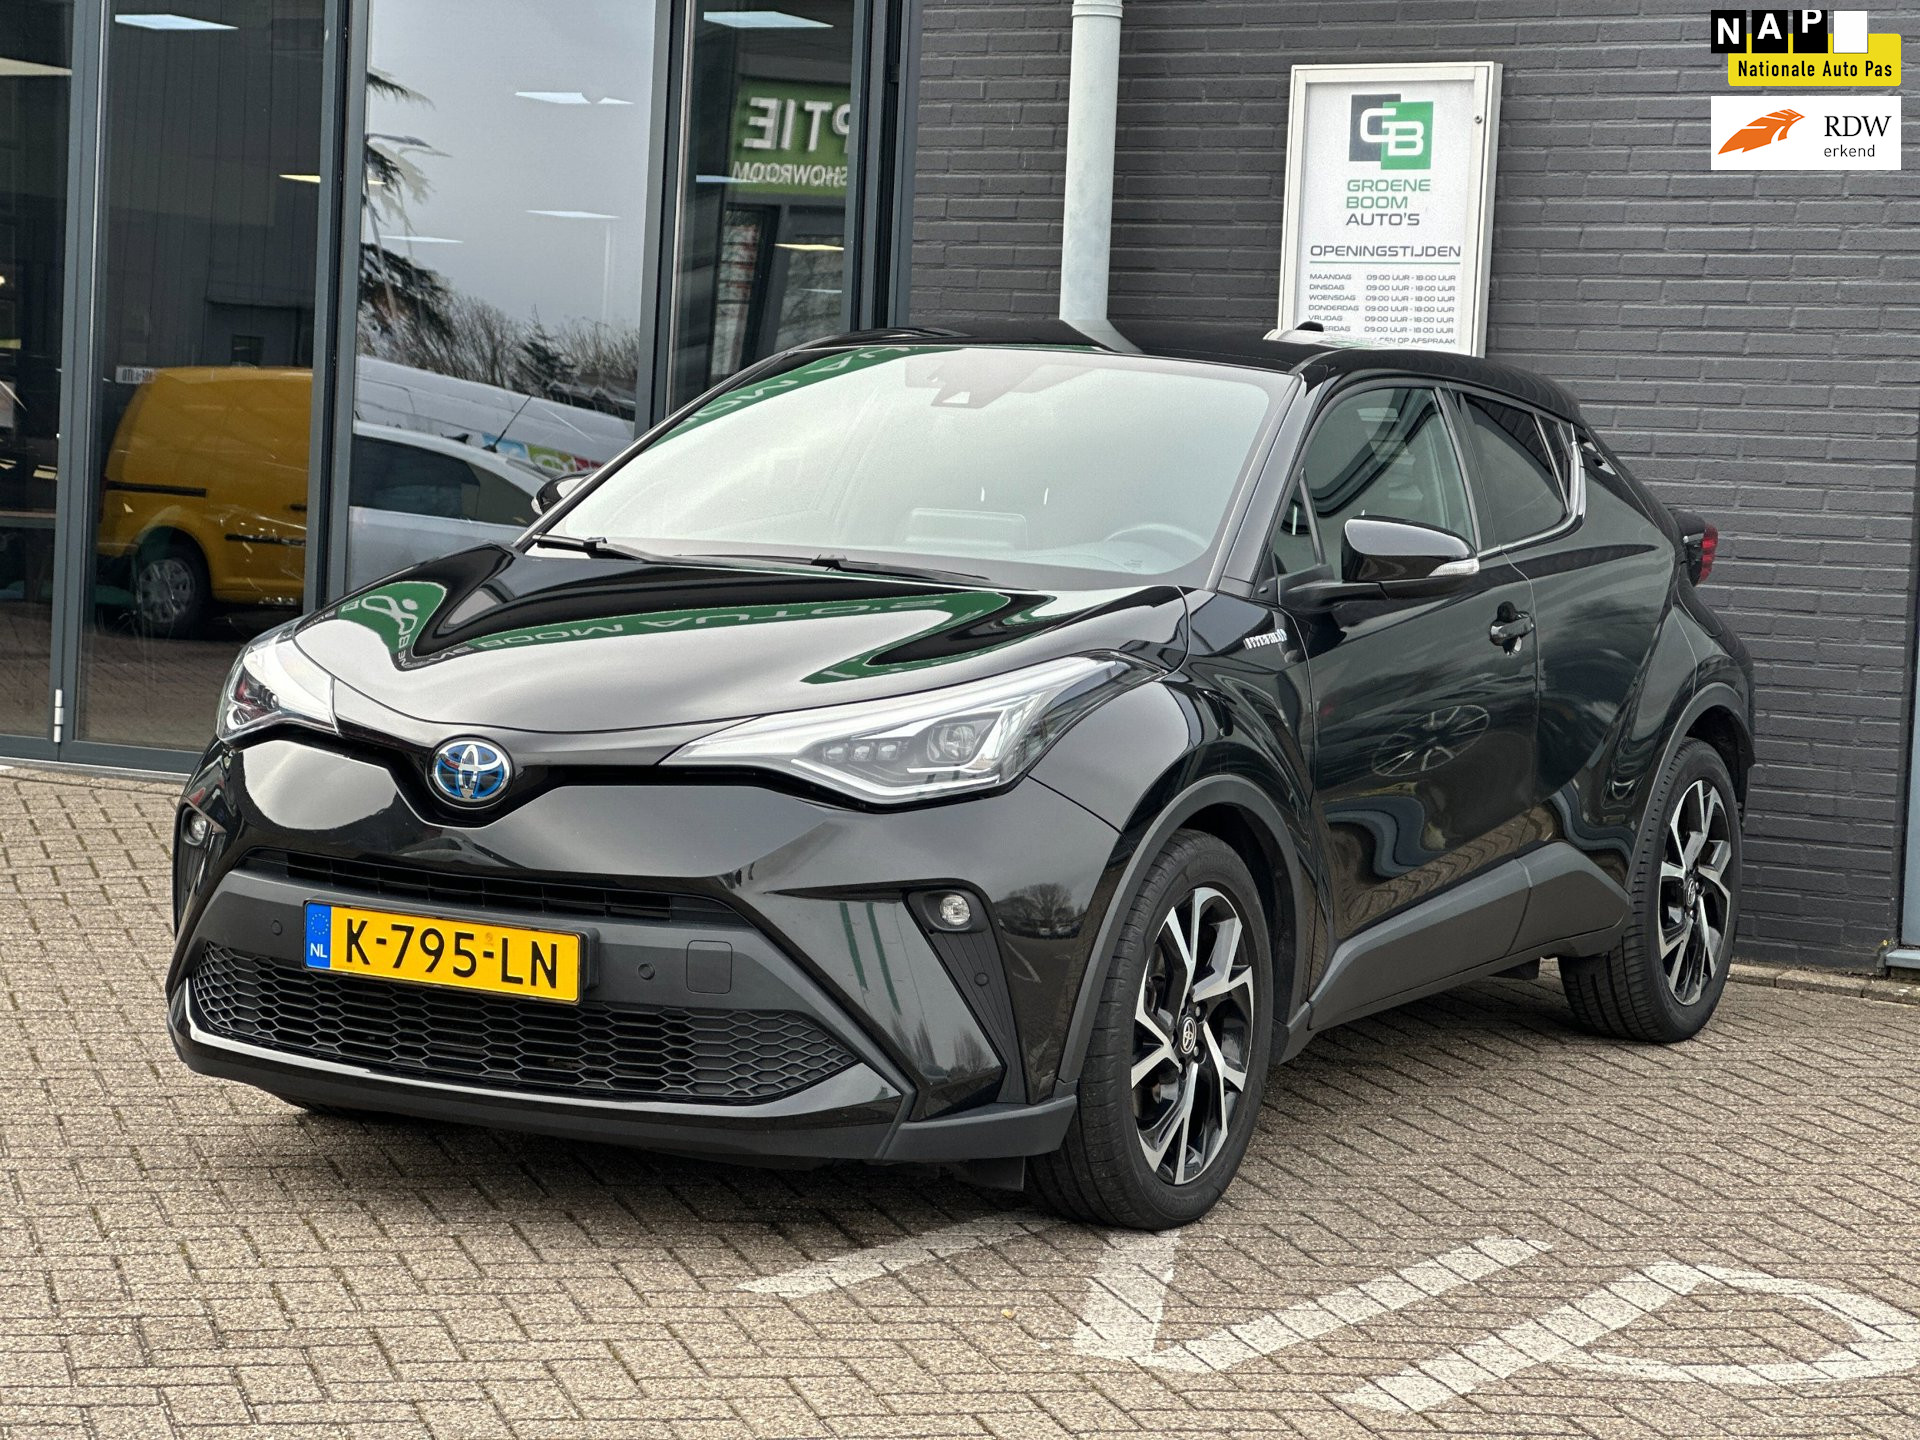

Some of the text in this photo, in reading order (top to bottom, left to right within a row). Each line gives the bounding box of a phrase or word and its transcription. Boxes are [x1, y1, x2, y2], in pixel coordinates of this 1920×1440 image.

[1347, 178, 1431, 192] GROENE
[1346, 195, 1408, 209] BOOM
[1346, 212, 1420, 226] AUTO'S
[1310, 245, 1462, 257] OPENINGSTIJDEN
[1437, 284, 1456, 292] UUR
[1437, 295, 1455, 303] UUR
[1437, 305, 1455, 313] UUR
[310, 943, 328, 959] NL
[346, 918, 558, 989] K-795-LN
